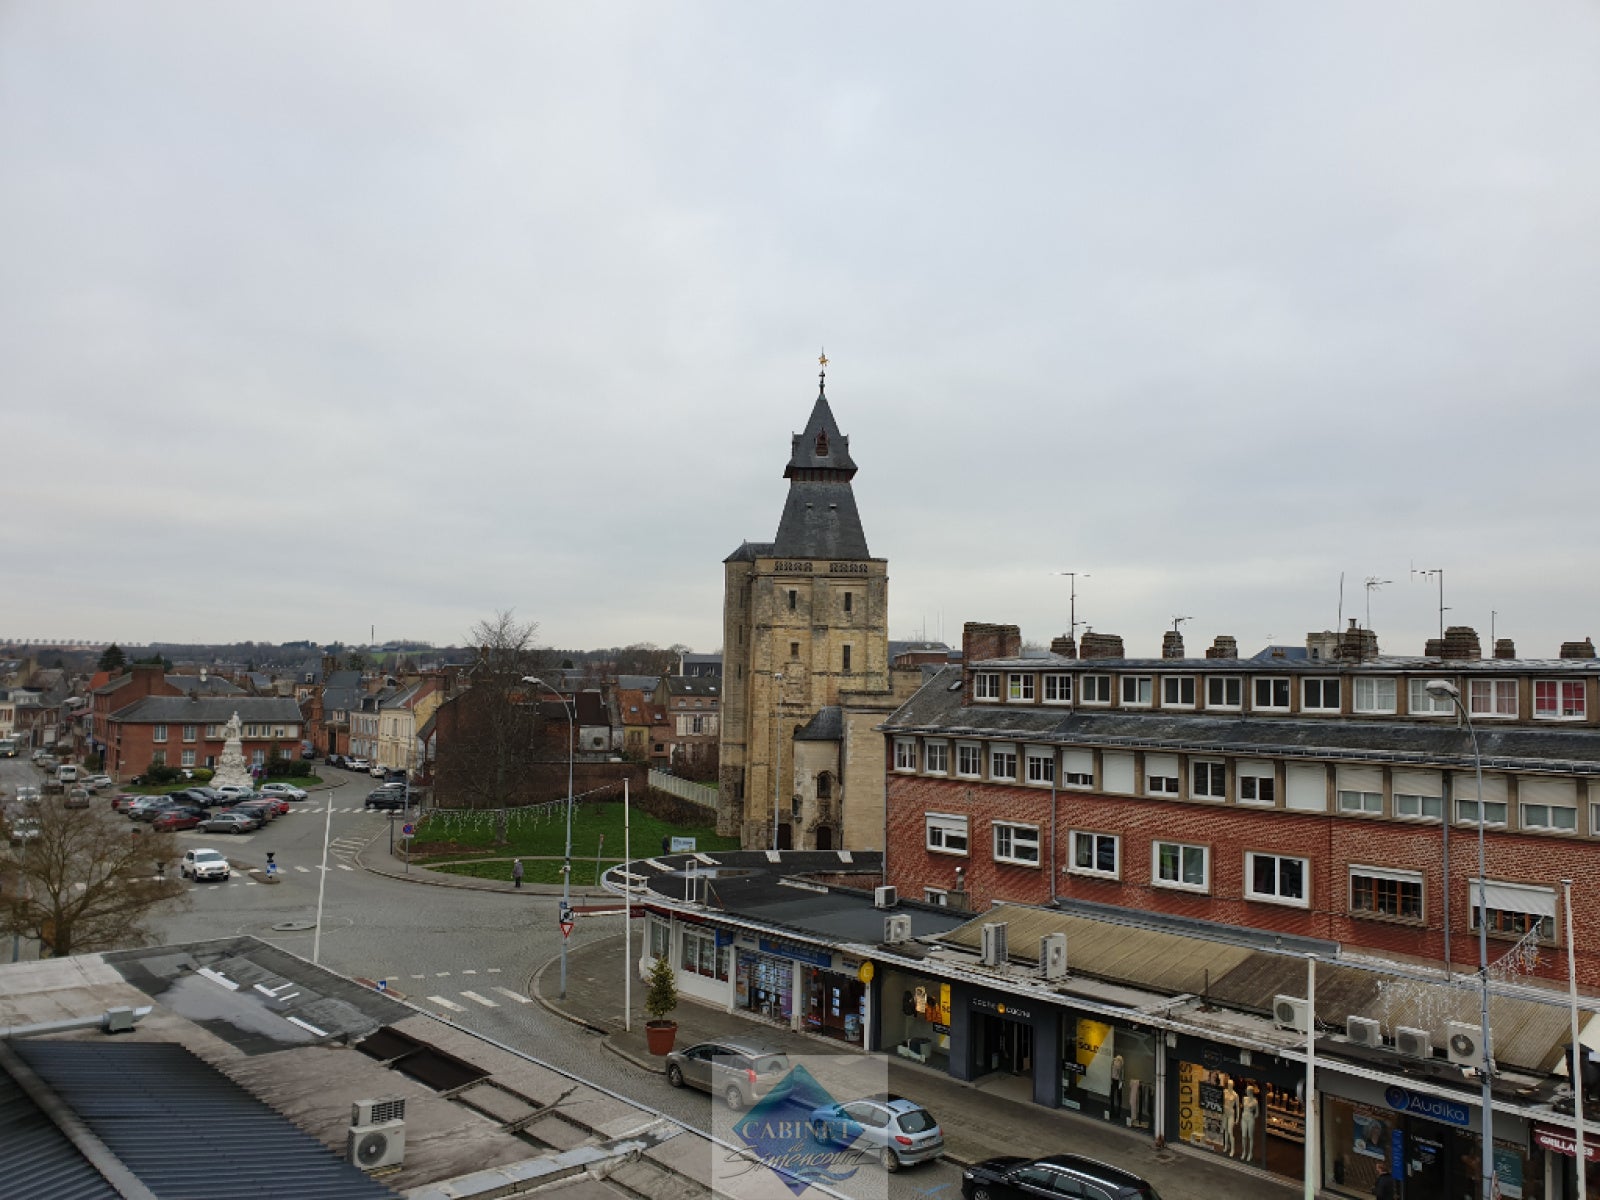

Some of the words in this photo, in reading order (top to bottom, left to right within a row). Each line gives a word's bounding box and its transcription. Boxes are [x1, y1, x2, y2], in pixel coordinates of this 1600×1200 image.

[1180, 1062, 1193, 1130] SOLDES
[1410, 1096, 1465, 1121] Audika
[1540, 1136, 1595, 1157] GRILLAES
